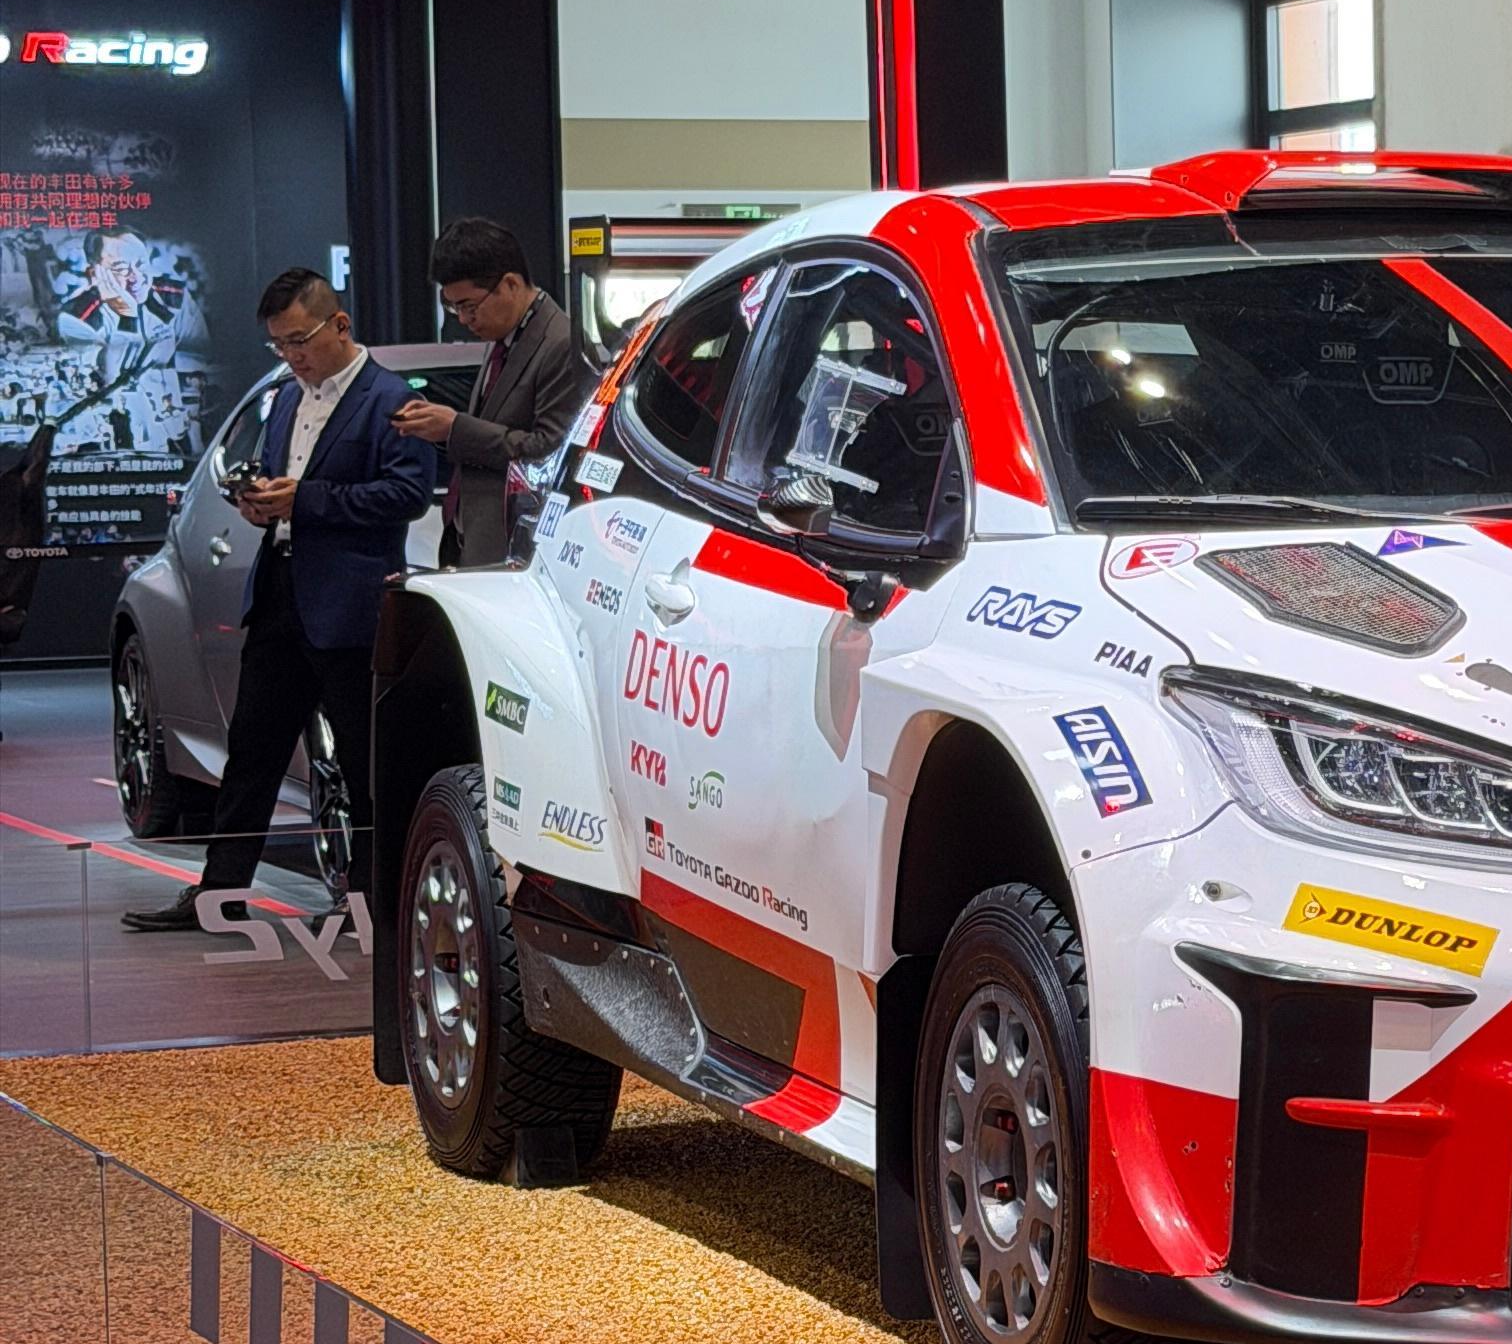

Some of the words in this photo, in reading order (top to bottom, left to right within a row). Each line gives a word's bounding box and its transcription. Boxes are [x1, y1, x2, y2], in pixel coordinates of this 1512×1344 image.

[20, 31, 208, 75] Racing
[1321, 344, 1357, 360] OMP
[1380, 362, 1434, 385] OMP
[24, 547, 69, 557] TOYOTA
[592, 581, 623, 616] ENEOS
[967, 586, 1083, 639] RAYS
[1094, 641, 1154, 678] PIAA
[624, 629, 730, 737] DENSO
[496, 695, 527, 725] SMBC
[631, 739, 667, 787] KYB
[1064, 713, 1140, 804] AISIN
[688, 775, 723, 809] SANGO
[541, 800, 608, 845] ENDLESS
[646, 832, 665, 860] GR
[667, 842, 713, 882] TOYOTA
[714, 866, 760, 904] GAZOO
[761, 886, 808, 931] Racing
[1326, 906, 1479, 953] DUNLOP
